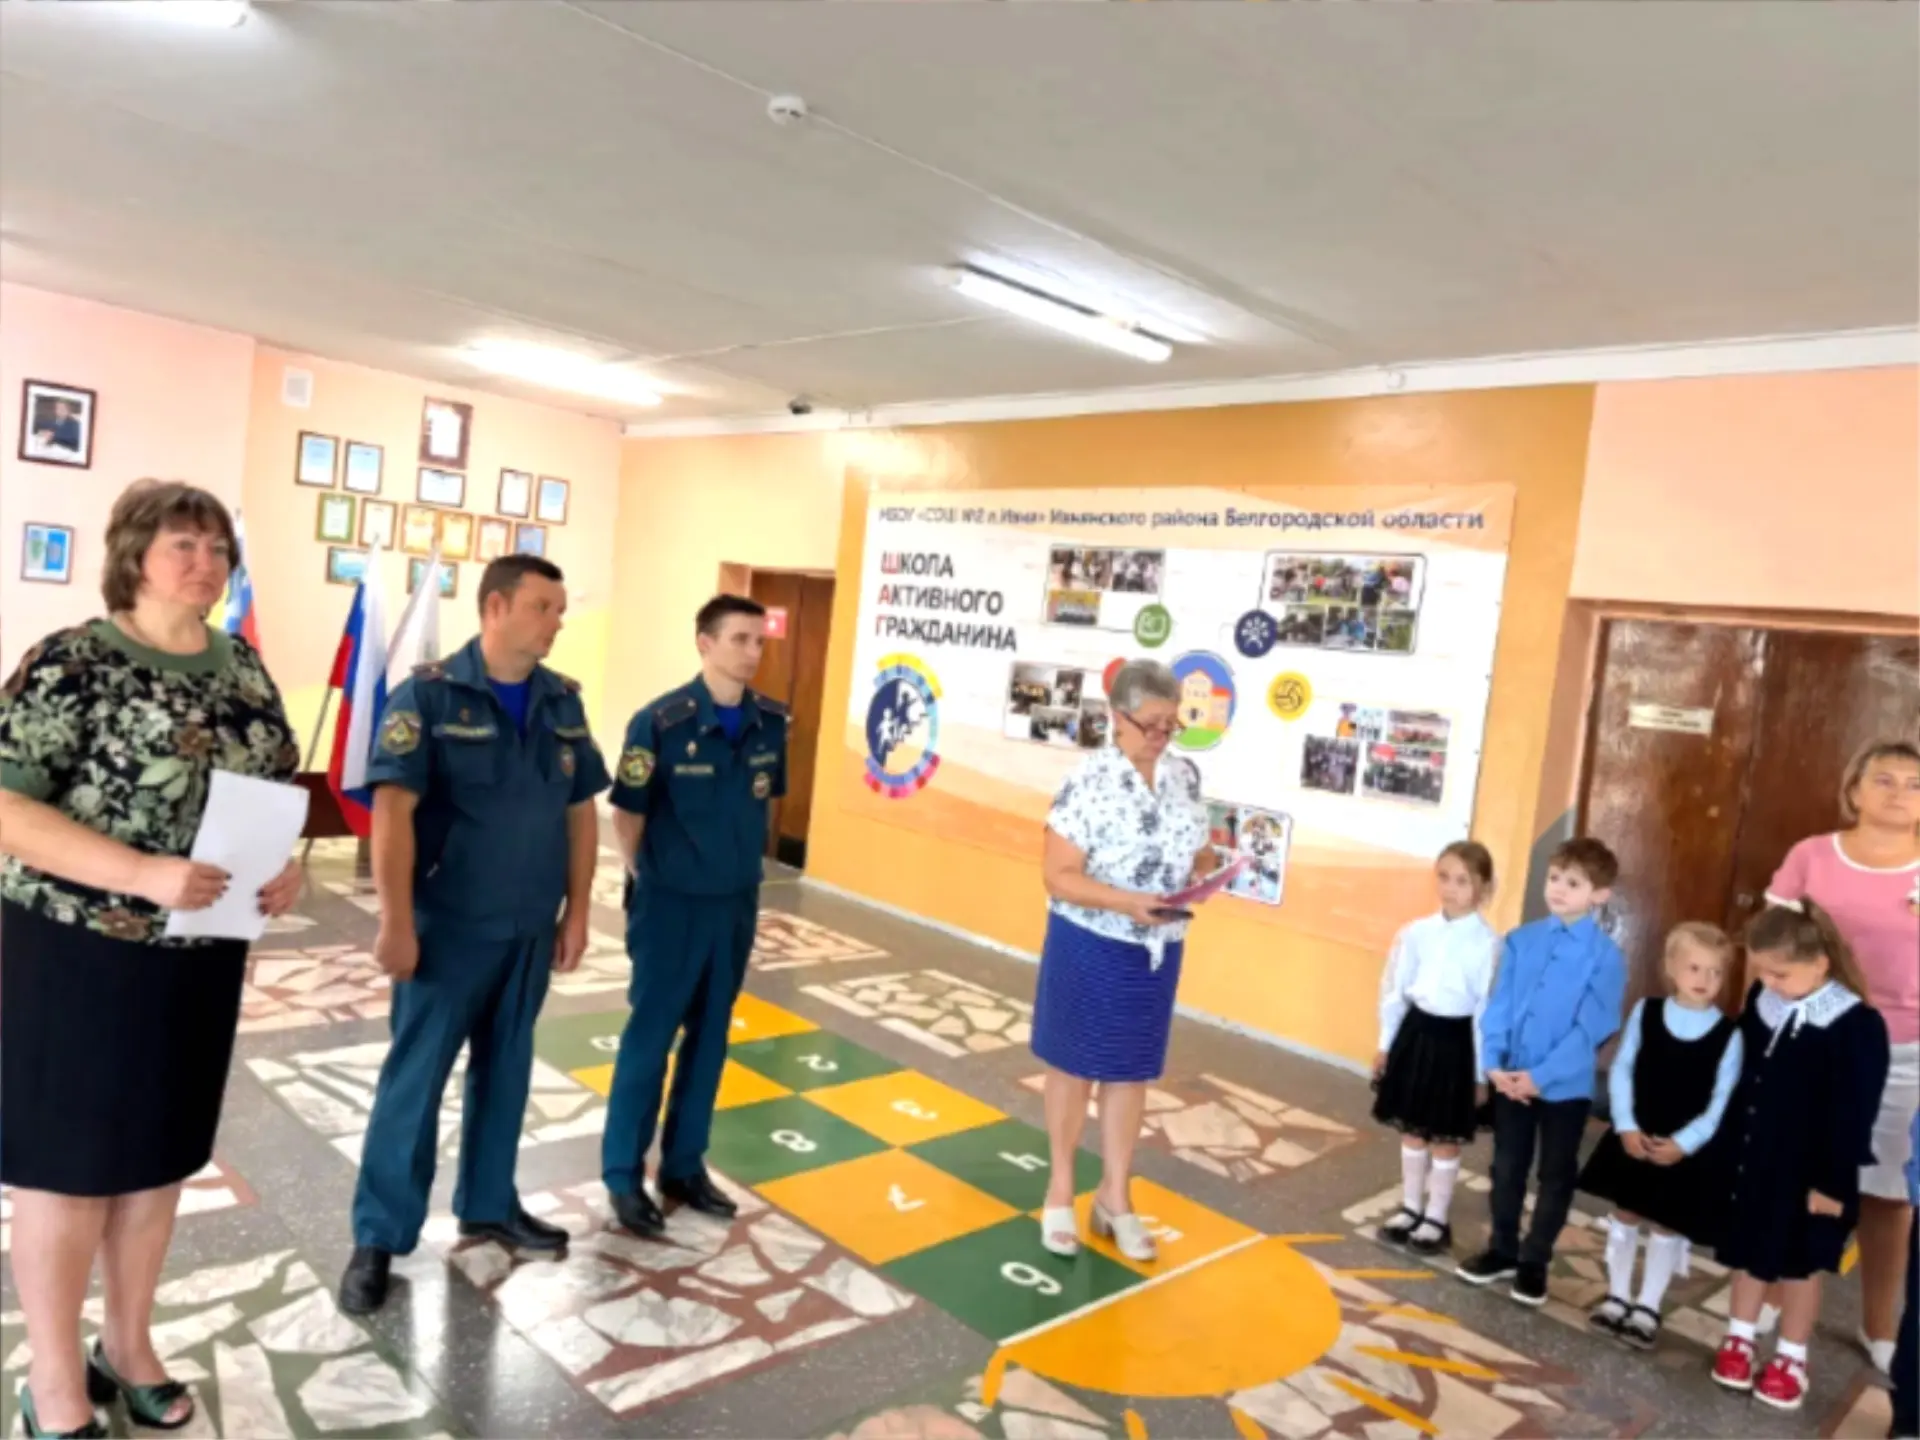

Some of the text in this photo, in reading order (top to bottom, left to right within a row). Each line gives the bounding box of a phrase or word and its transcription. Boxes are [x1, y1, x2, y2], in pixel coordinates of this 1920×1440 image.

[1050, 507, 1147, 527] Ивнянского
[1152, 508, 1218, 529] района
[1225, 507, 1375, 530] Белгородской
[1381, 508, 1484, 530] области
[881, 551, 954, 578] ШКОЛА
[878, 583, 1004, 616] АКТИВНОГО
[875, 613, 1017, 652] ГРАЖДАНИНА
[796, 1052, 838, 1073] 2
[769, 1128, 818, 1153] 8
